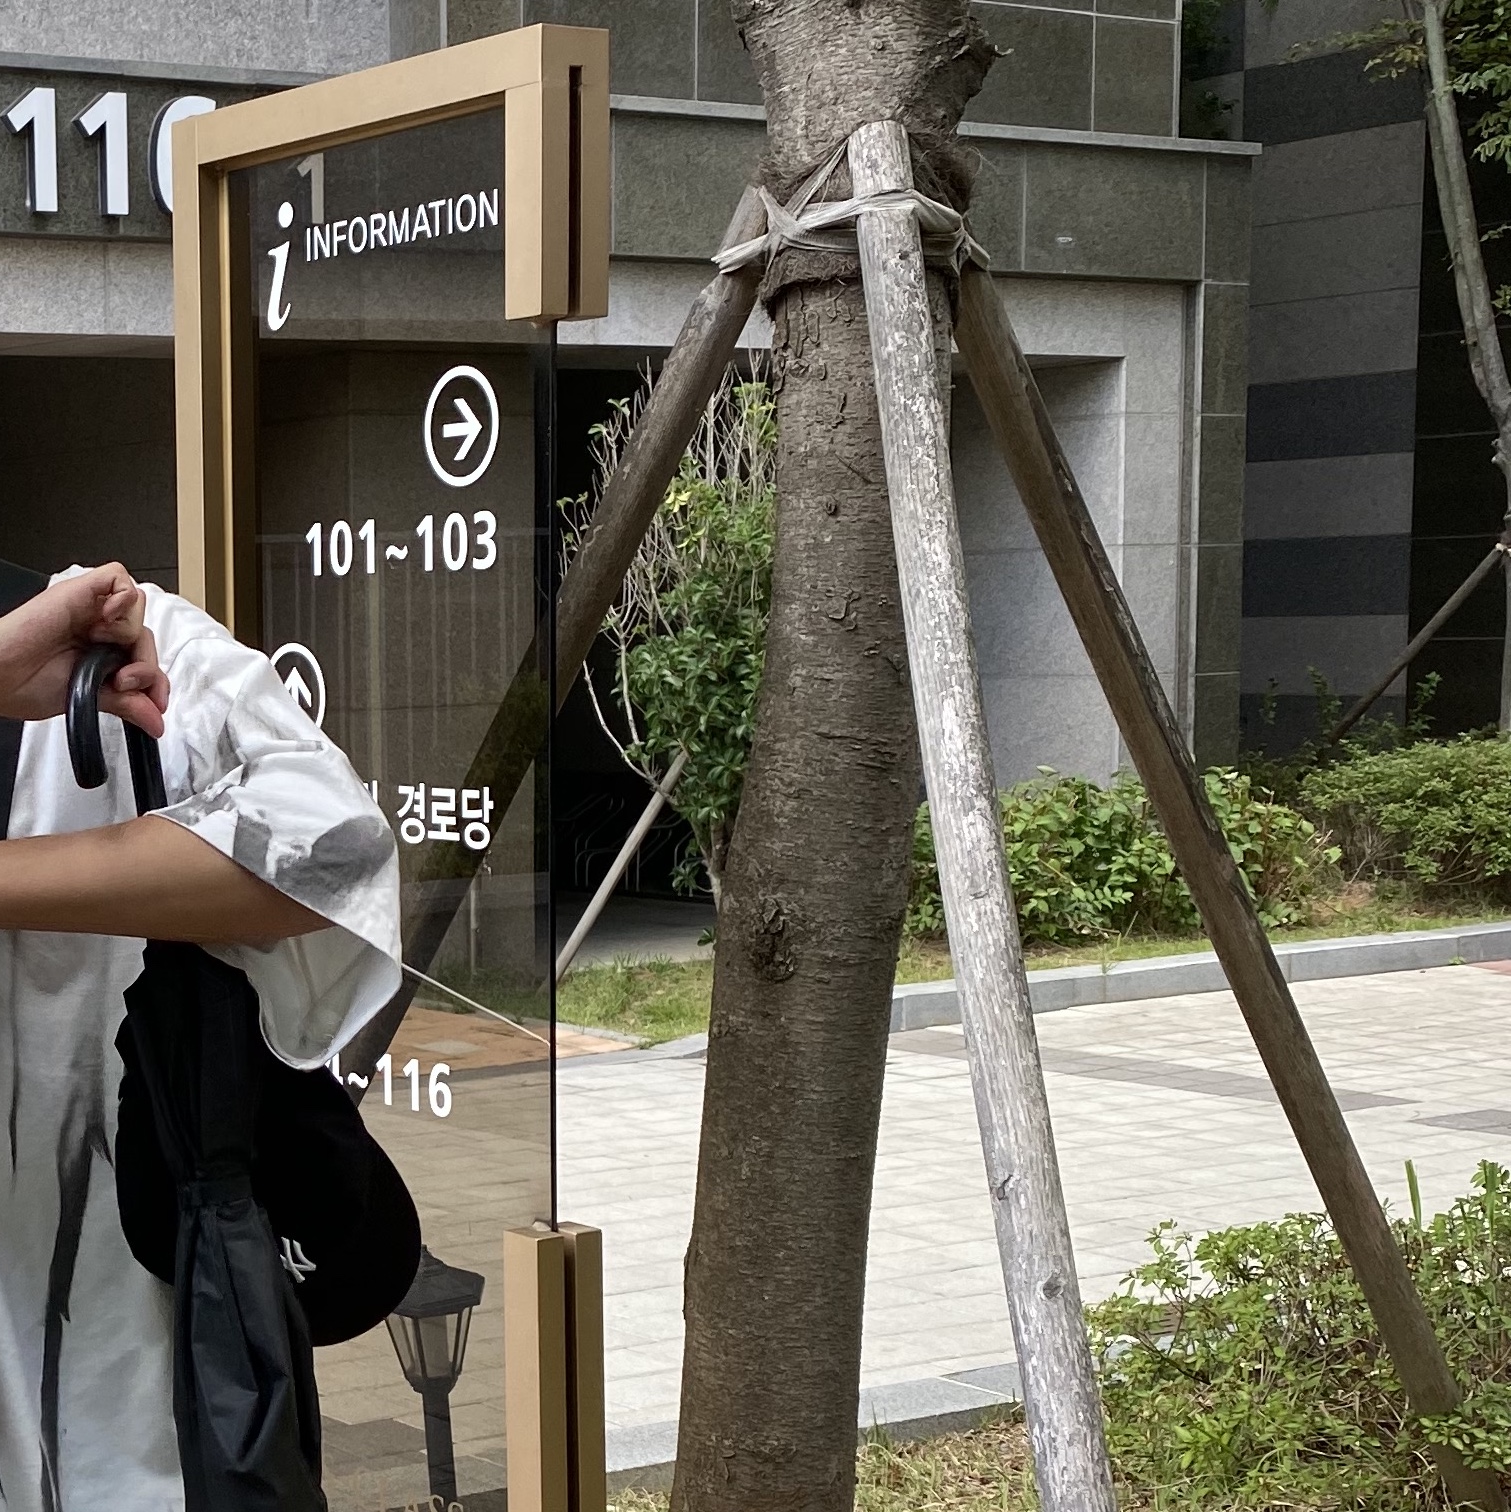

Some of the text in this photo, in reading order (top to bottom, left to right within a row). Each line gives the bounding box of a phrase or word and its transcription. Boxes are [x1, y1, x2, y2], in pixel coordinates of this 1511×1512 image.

[305, 188, 500, 263] INFORMATION
[305, 510, 498, 576] 101~103
[395, 782, 495, 851] 경로당
